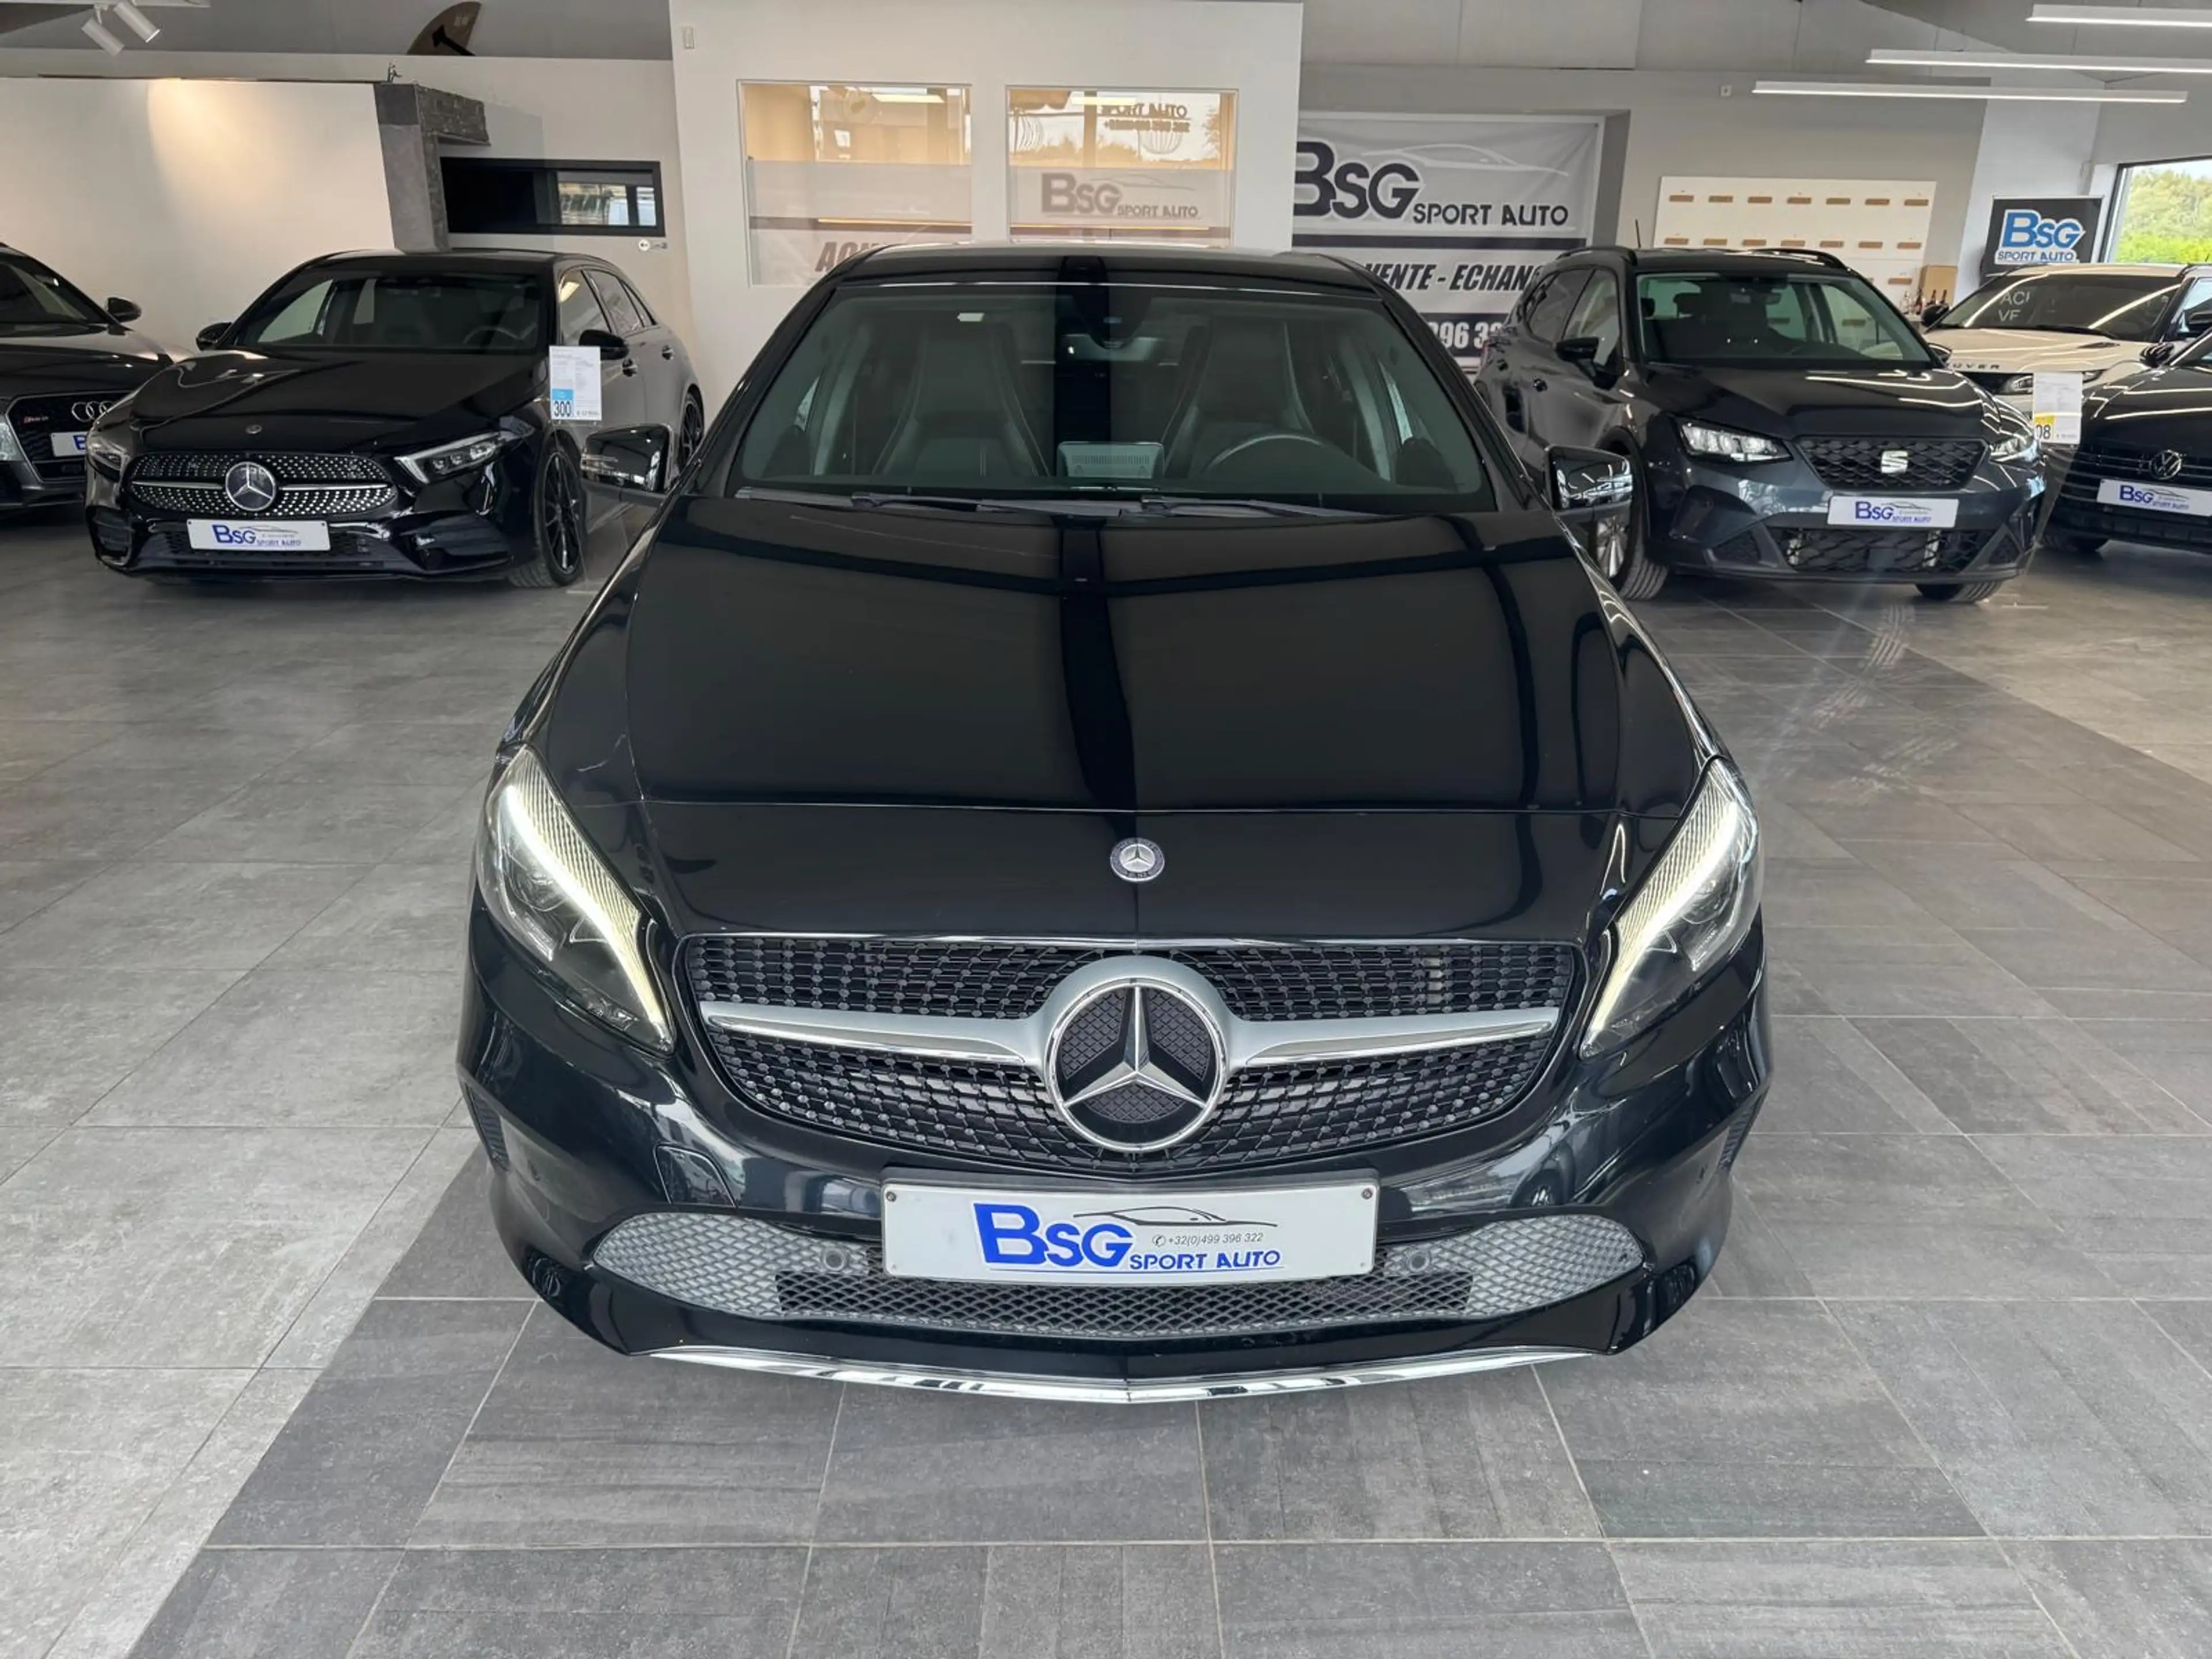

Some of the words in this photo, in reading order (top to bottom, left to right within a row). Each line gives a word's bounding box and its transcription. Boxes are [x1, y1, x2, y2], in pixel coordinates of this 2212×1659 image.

[1118, 204, 1158, 217] SPORT
[1162, 204, 1198, 218] AUTO
[1413, 203, 1493, 225] SPORT
[1501, 204, 1569, 226] AUTO
[1998, 251, 2036, 261] SPORT
[2040, 251, 2075, 261] AUTO
[1222, 1233, 1242, 1244] 396
[1244, 1232, 1264, 1243] 322
[1129, 1253, 1208, 1270] SPORT
[1216, 1249, 1281, 1268] AUTO
